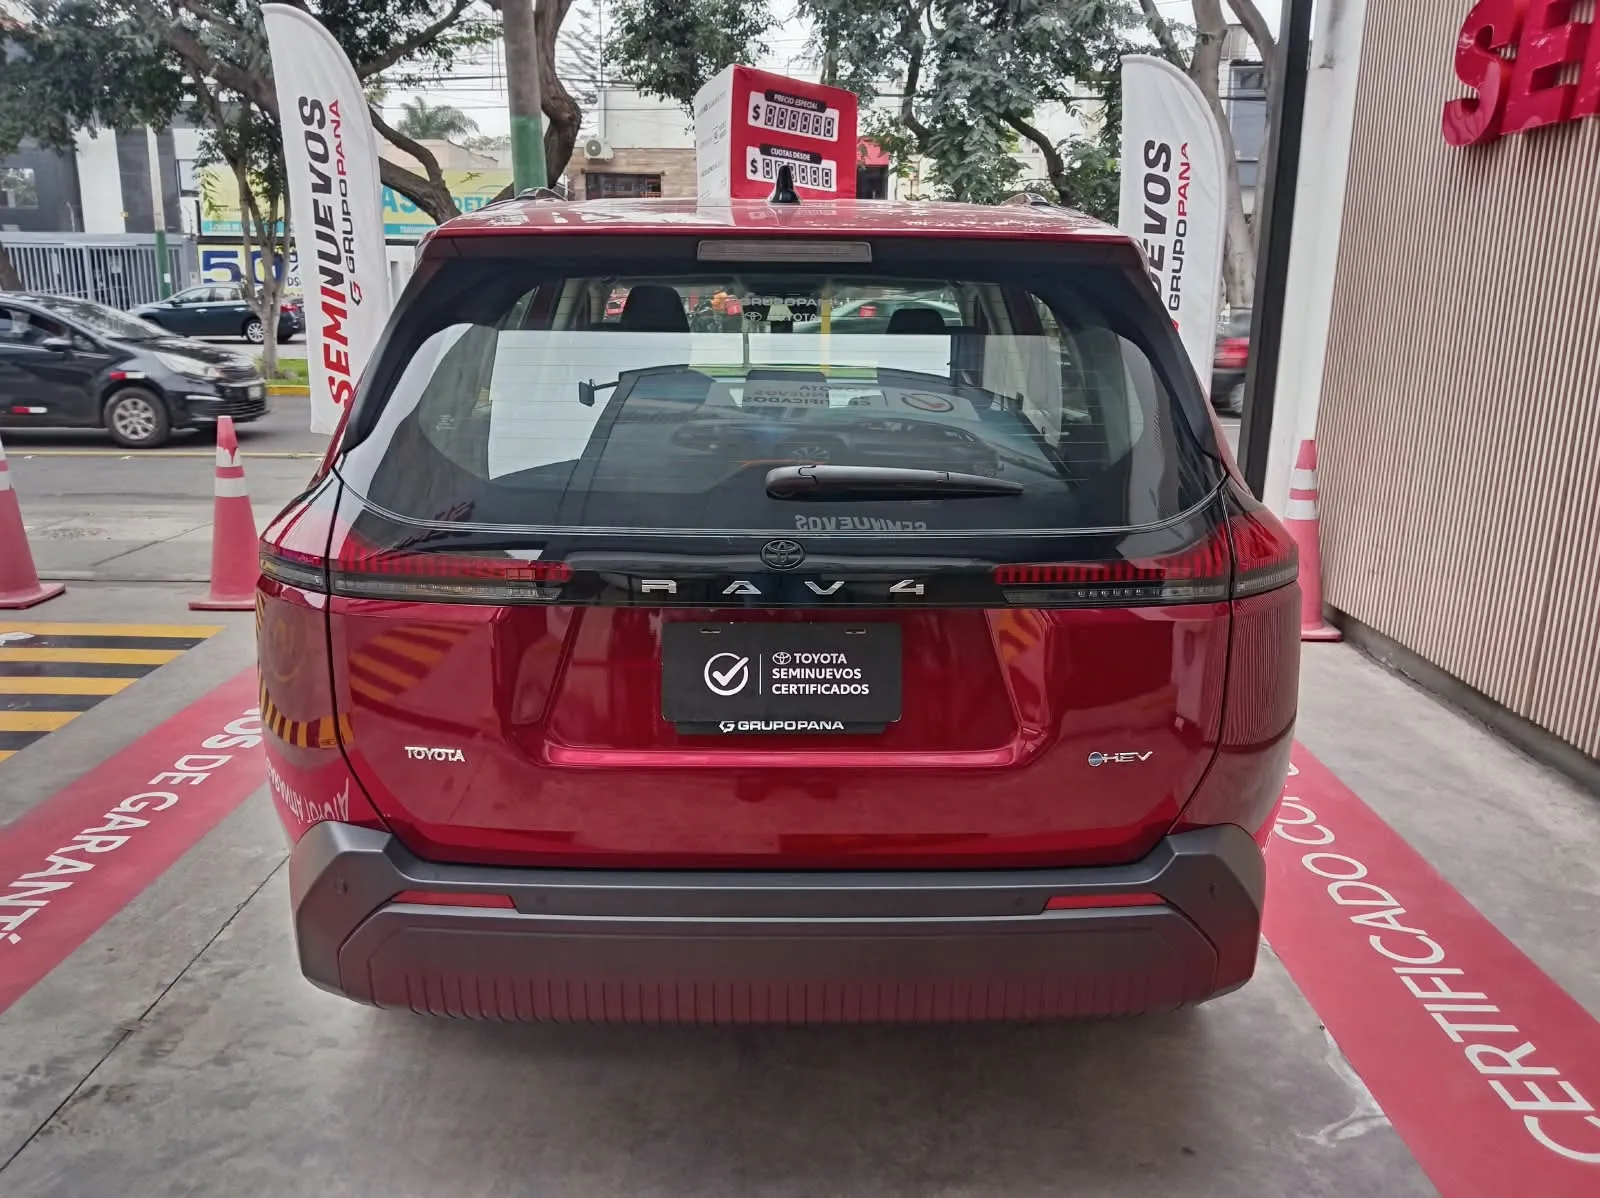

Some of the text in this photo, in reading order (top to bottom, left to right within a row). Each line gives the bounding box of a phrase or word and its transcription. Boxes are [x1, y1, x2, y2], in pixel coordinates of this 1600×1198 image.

[1443, 0, 1600, 147] SE
[774, 94, 819, 110] PRECIO ESPECIAL
[771, 148, 811, 161] CUOTAS DESDE
[298, 96, 354, 405] SEMINUEVOS
[641, 579, 925, 595] RAV4
[794, 653, 848, 664] TOYOTA
[772, 668, 862, 679] SEMINUEVOS
[772, 684, 870, 695] CERTIFICADOS
[404, 746, 466, 762] TOYOTA
[0, 707, 263, 945] OS DE GARANT
[1301, 852, 1600, 1164] CERTIFICADO
